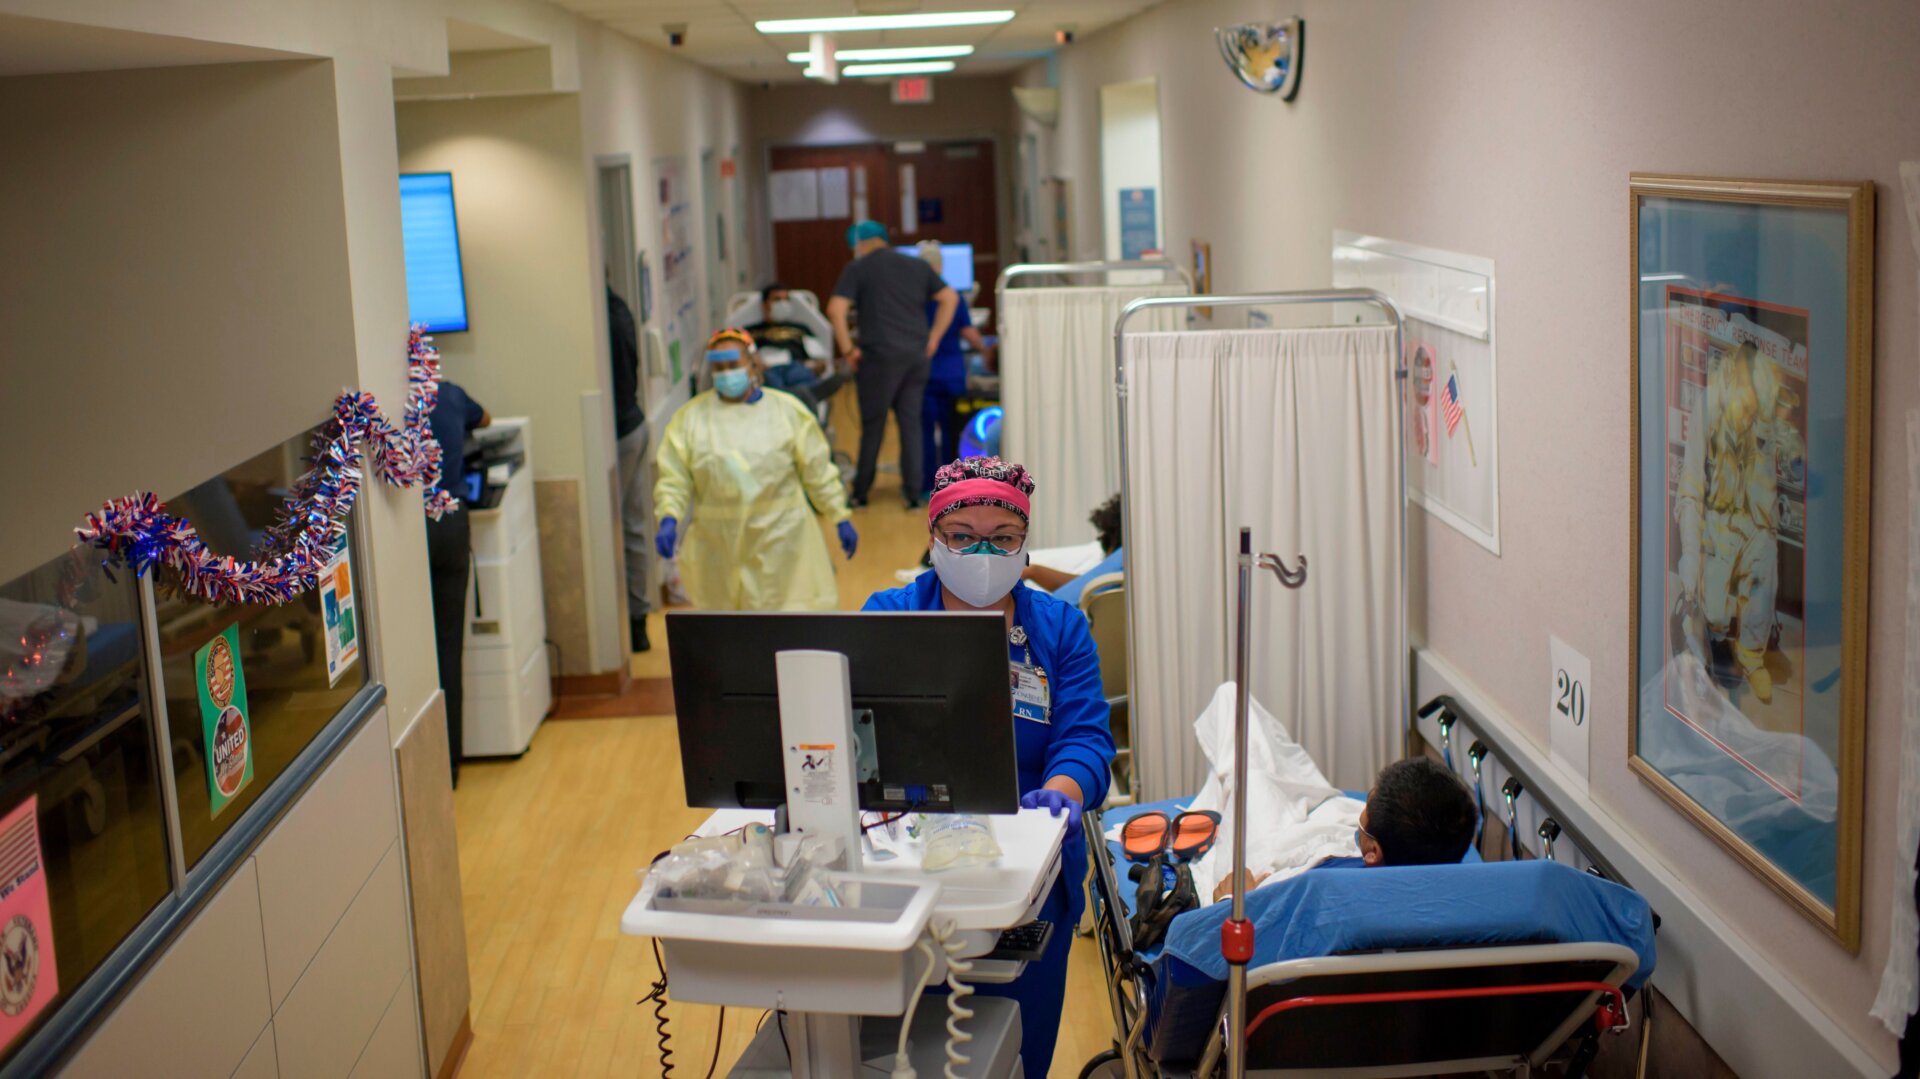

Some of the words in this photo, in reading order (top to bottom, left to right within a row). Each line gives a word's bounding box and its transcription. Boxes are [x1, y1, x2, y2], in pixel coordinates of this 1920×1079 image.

[1679, 303, 1730, 337] EMERGENCY
[1732, 326, 1778, 359] RESPONSE
[1019, 707, 1033, 717] RN
[1557, 668, 1585, 726] 20
[216, 728, 245, 764] UNITED
